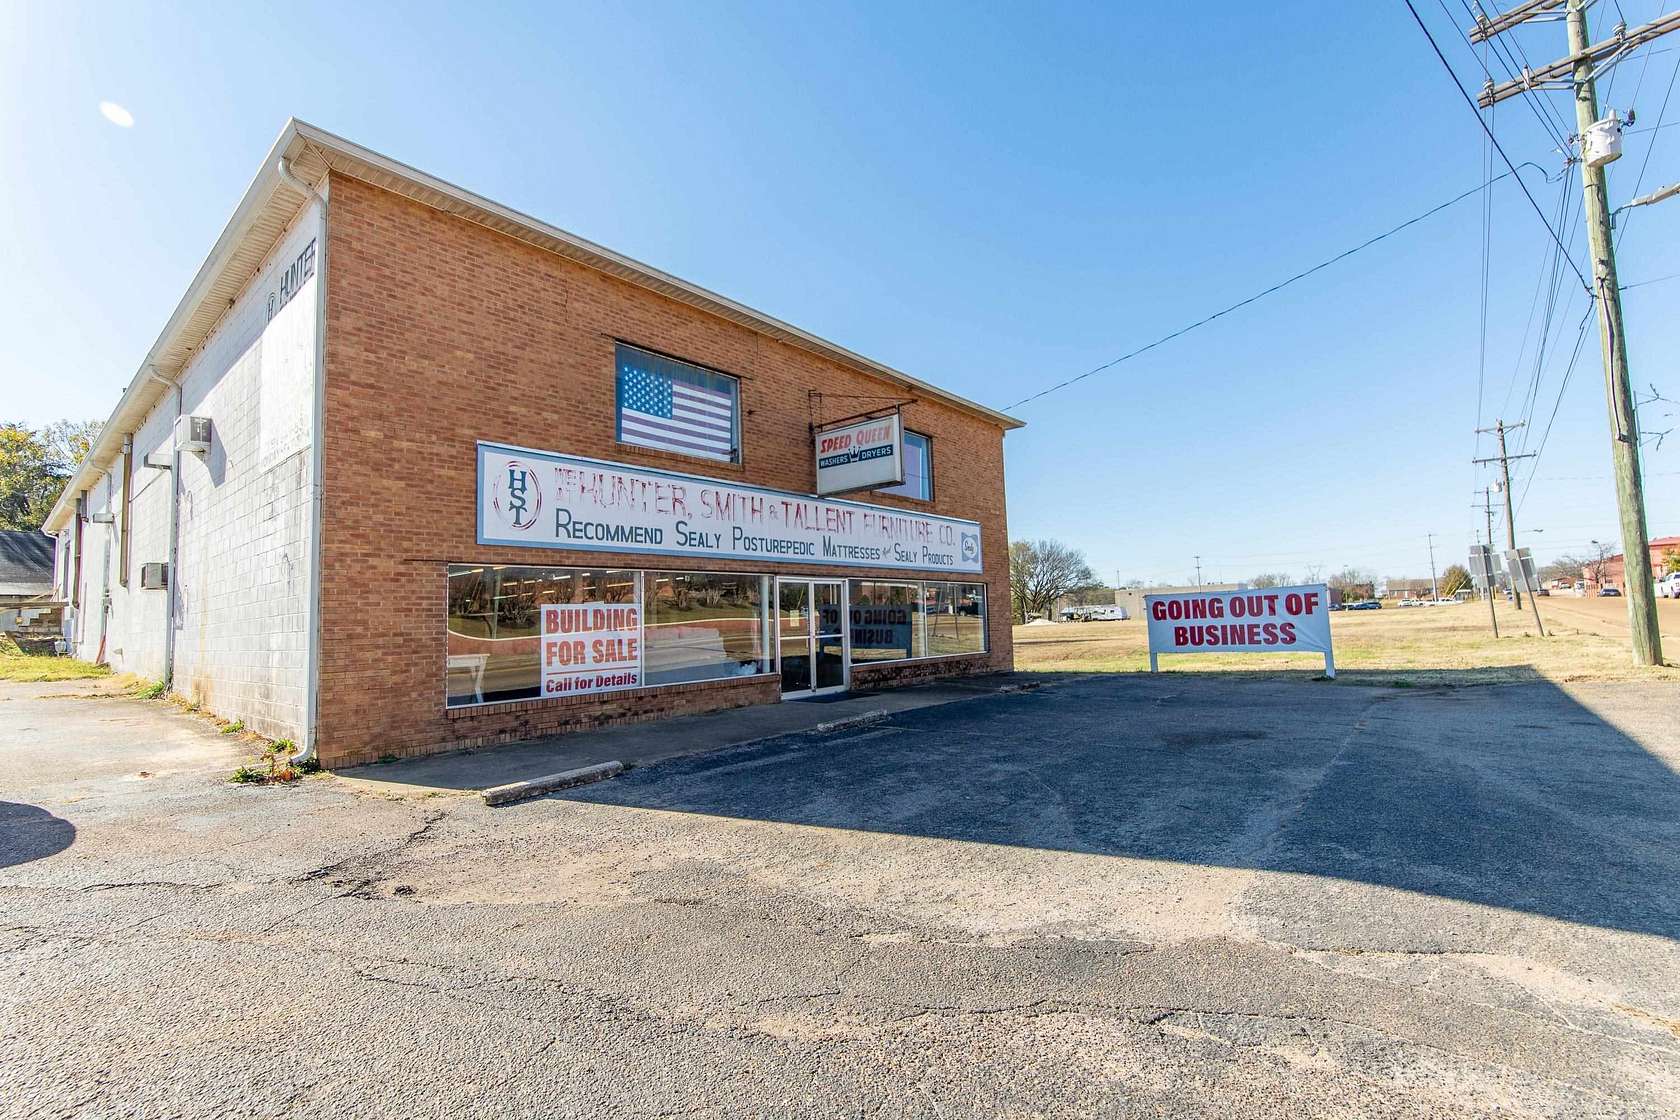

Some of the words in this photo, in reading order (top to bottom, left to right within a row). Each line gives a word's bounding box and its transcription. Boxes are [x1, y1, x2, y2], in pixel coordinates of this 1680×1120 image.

[820, 433, 852, 454] SPEED
[855, 424, 891, 446] QUEEN
[820, 454, 848, 468] WASHERS
[861, 446, 892, 459] DRYERS
[579, 470, 693, 519] HUNTER,
[700, 489, 764, 524] SMITH
[769, 504, 779, 520] &
[781, 501, 856, 535] TALLENT
[863, 512, 934, 544] FURNITURE
[939, 524, 957, 546] CO.
[555, 508, 663, 545] RECOMMEND
[675, 520, 722, 549] SEALY
[732, 526, 815, 556] POSTUREPEDIC
[822, 535, 881, 560] MATTRESSES
[894, 542, 917, 563] SEALY
[922, 545, 954, 566] PRODUCTS
[545, 608, 638, 634] BUILDING
[1152, 597, 1224, 621] GOING
[1229, 594, 1278, 618] OUT
[1285, 592, 1319, 616] OF
[1174, 622, 1297, 646] BUSINESS
[546, 640, 586, 667] FOR
[592, 638, 638, 664] SALE
[546, 677, 572, 693] Call
[574, 676, 593, 690] for
[595, 672, 638, 688] Details
